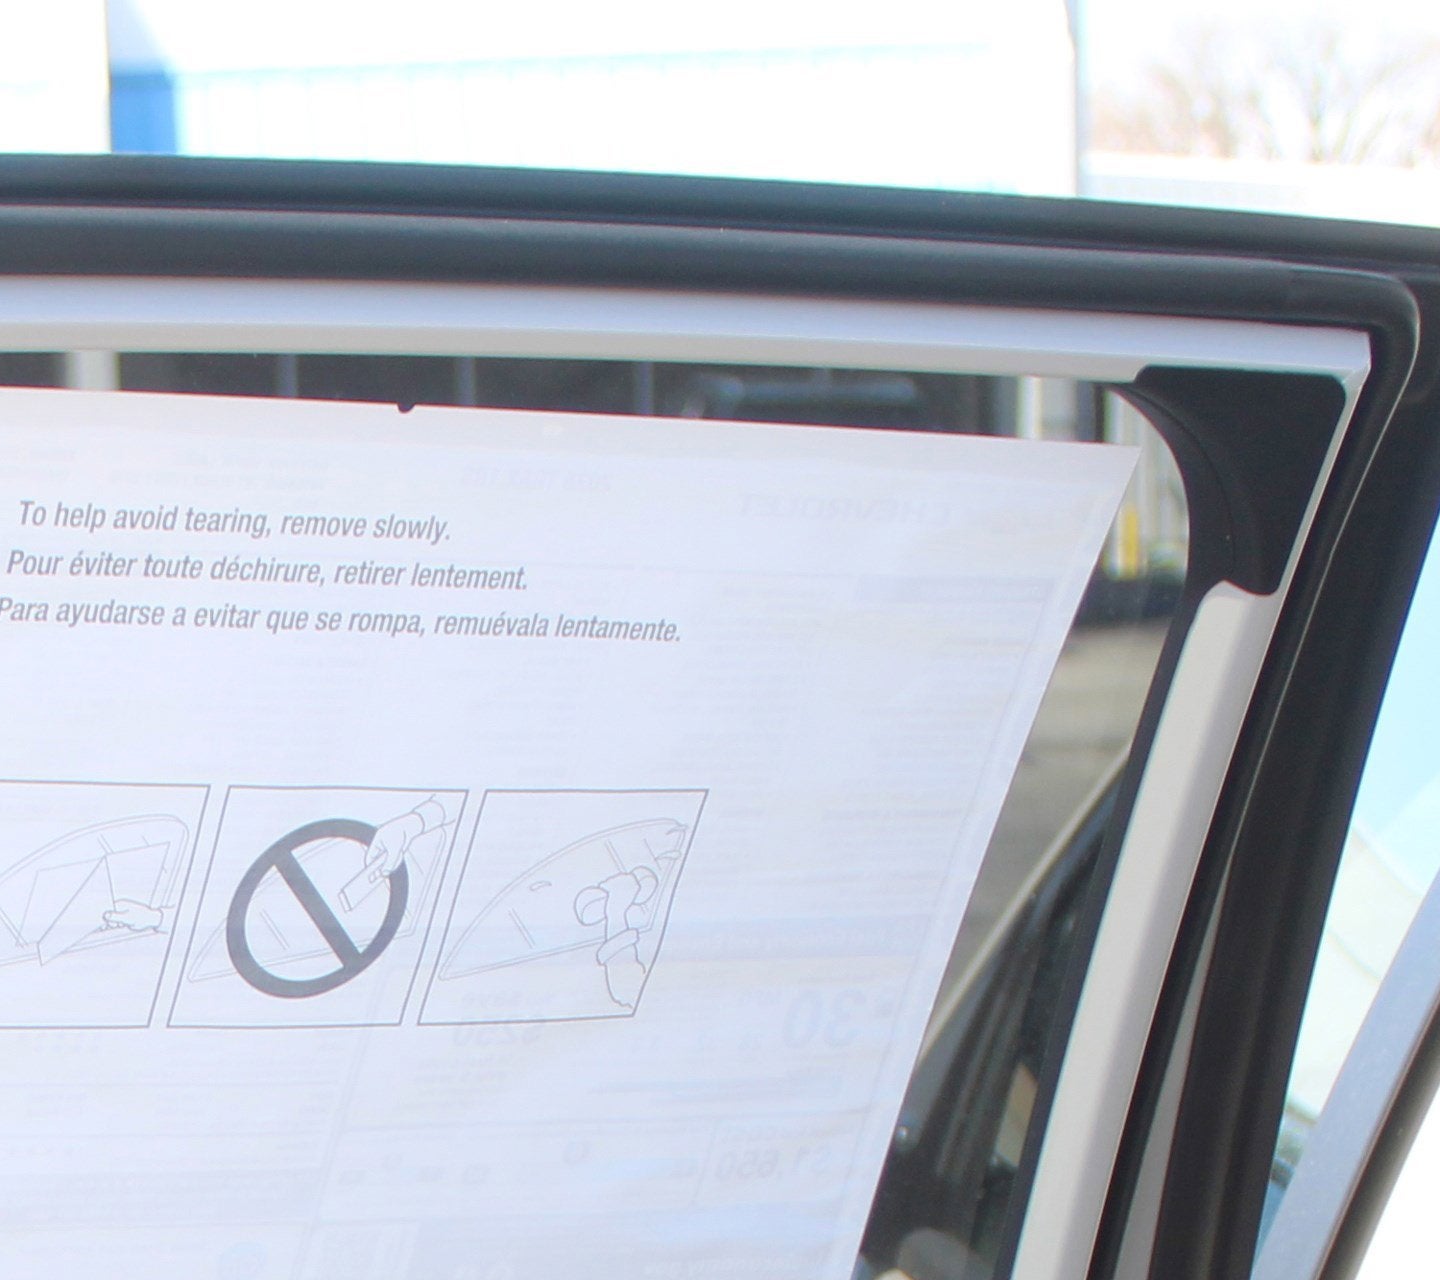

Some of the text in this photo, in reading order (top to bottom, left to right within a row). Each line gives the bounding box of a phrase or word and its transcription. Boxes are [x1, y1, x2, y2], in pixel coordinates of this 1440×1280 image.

[19, 499, 450, 546] To help avoid tearing, remove slowly.
[6, 548, 528, 591] Pour éviter toute déchirure, retirer lentement.
[55, 598, 166, 629] ayudarse
[171, 606, 187, 627] a
[193, 602, 262, 629] evitar
[265, 609, 310, 635] que
[314, 611, 343, 632] se
[347, 612, 426, 638] rompa,
[433, 610, 550, 638] remuévala
[553, 613, 681, 643] lentamente.
